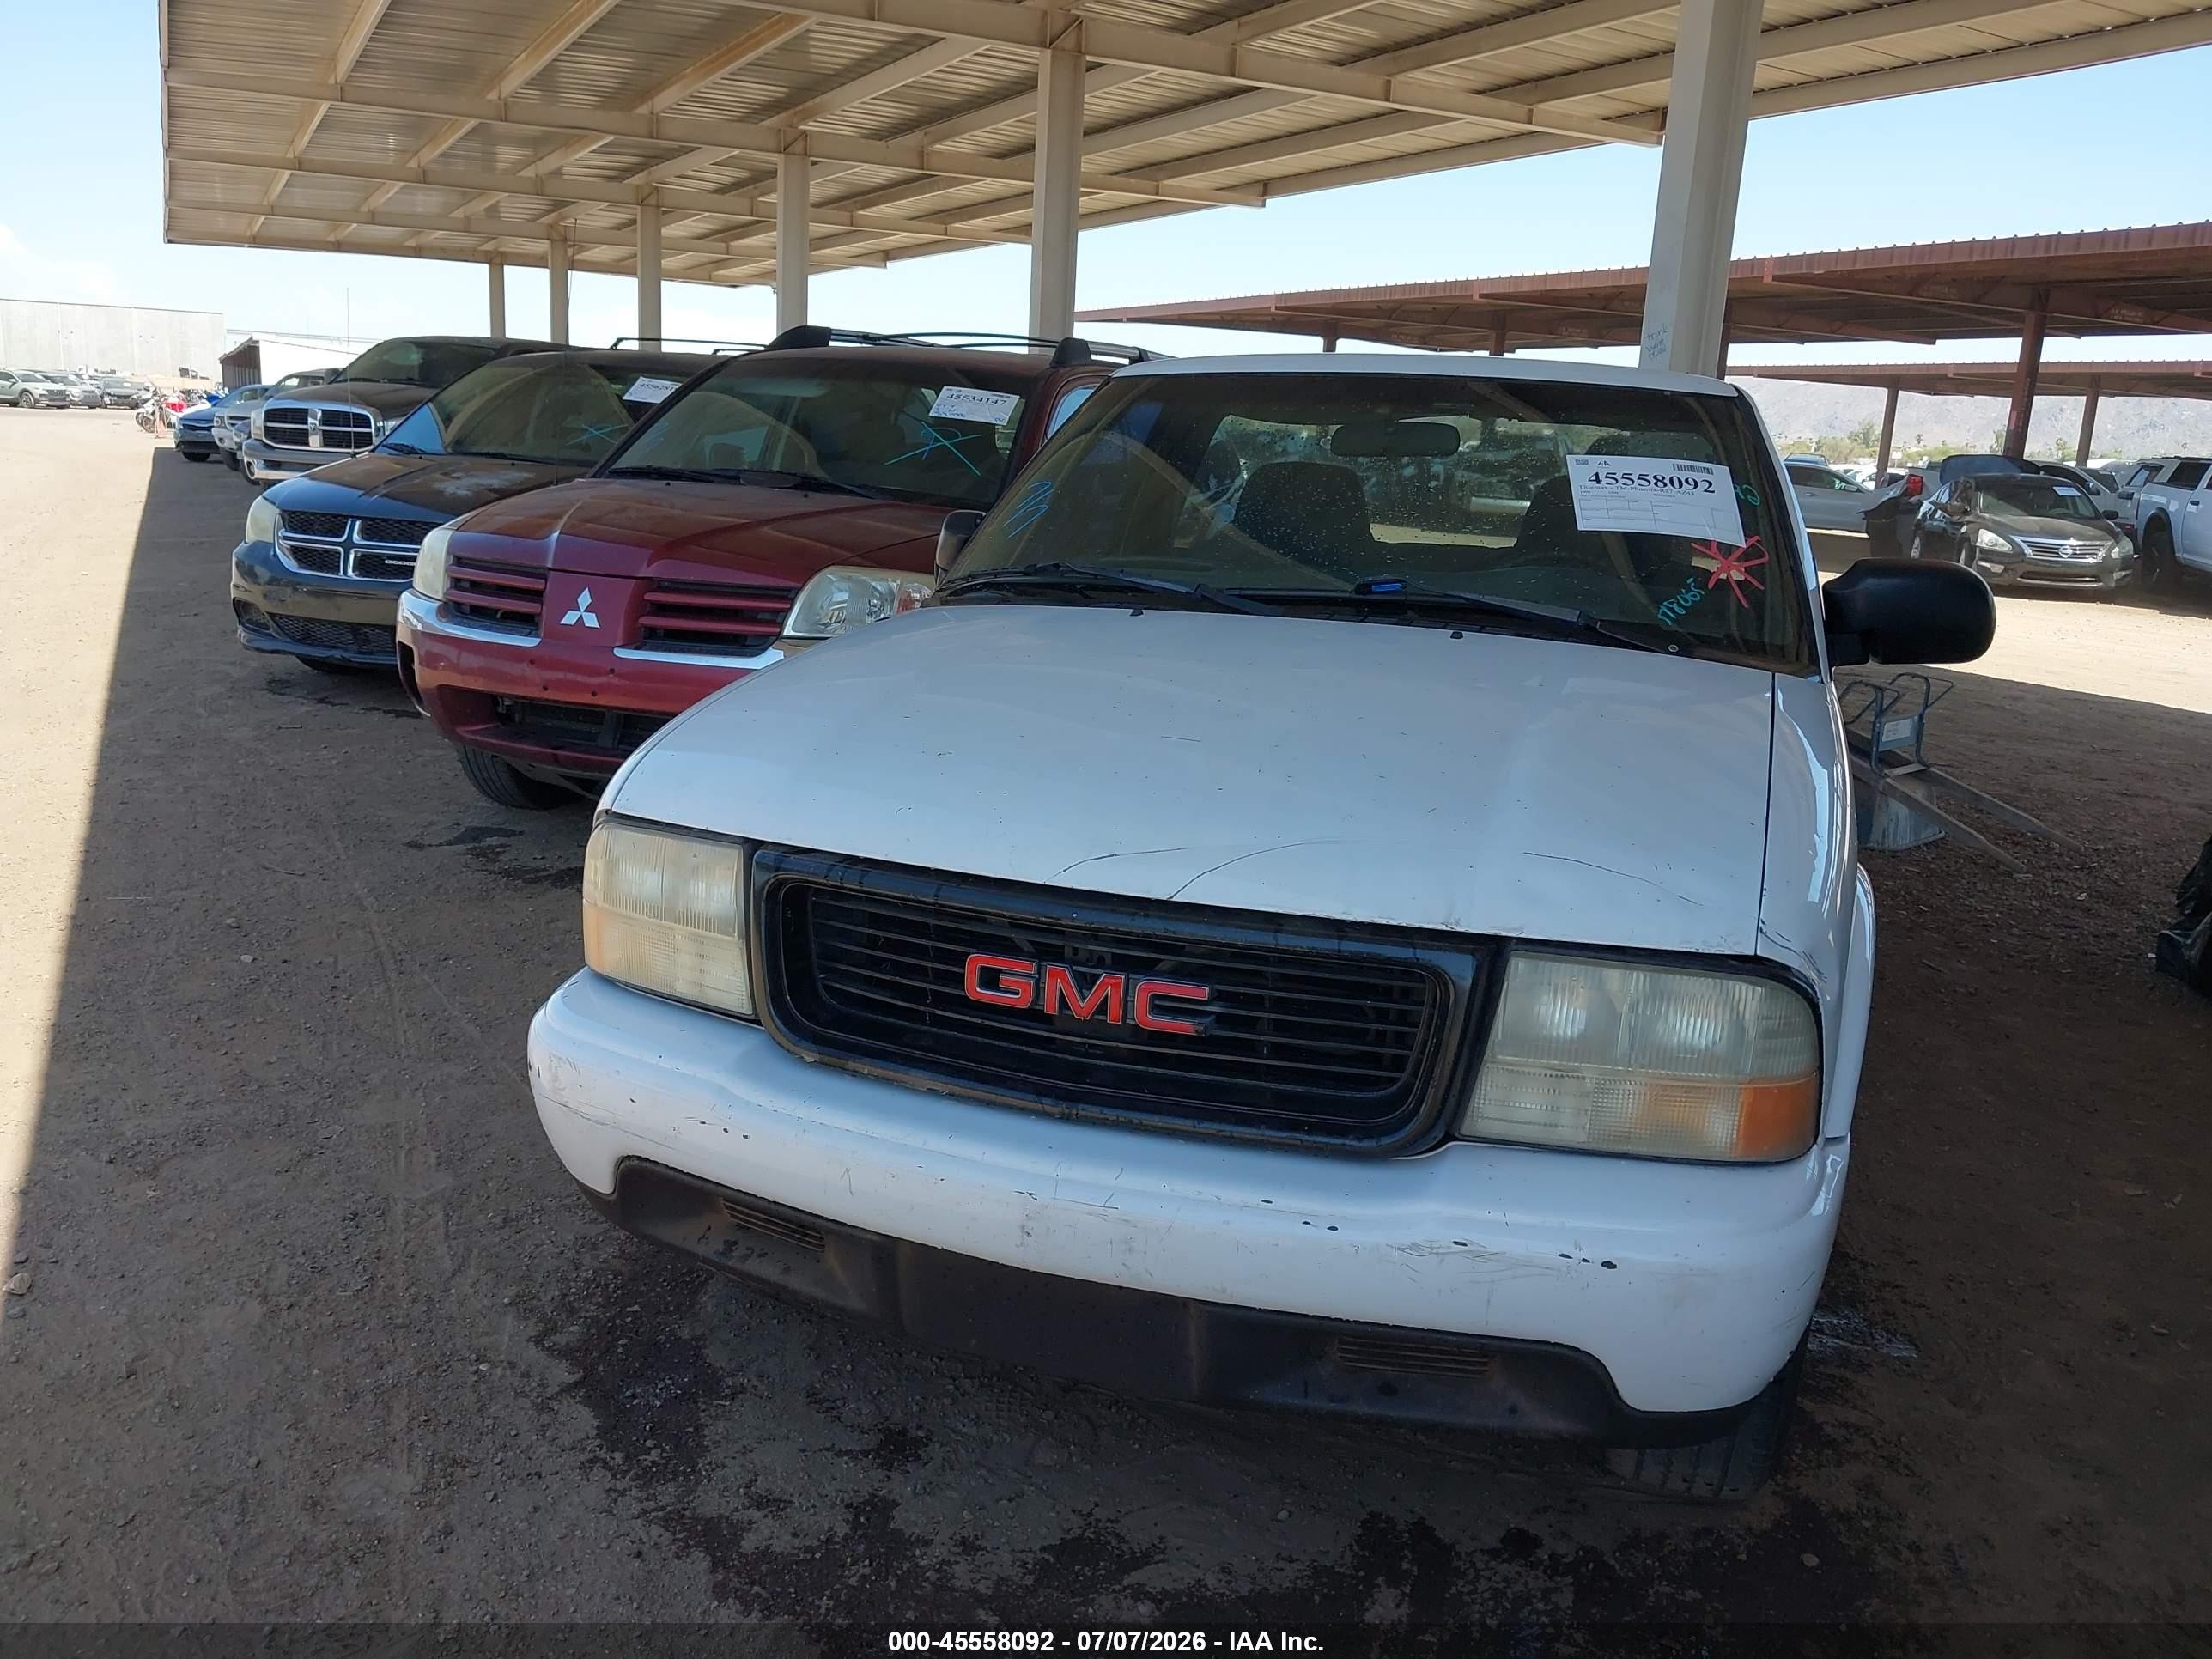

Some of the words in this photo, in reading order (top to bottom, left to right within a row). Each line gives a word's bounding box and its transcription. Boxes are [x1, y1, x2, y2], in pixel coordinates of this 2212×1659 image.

[947, 393, 1007, 405] 45534147
[1588, 471, 1716, 494] 45558092
[964, 953, 1210, 1036] GMC
